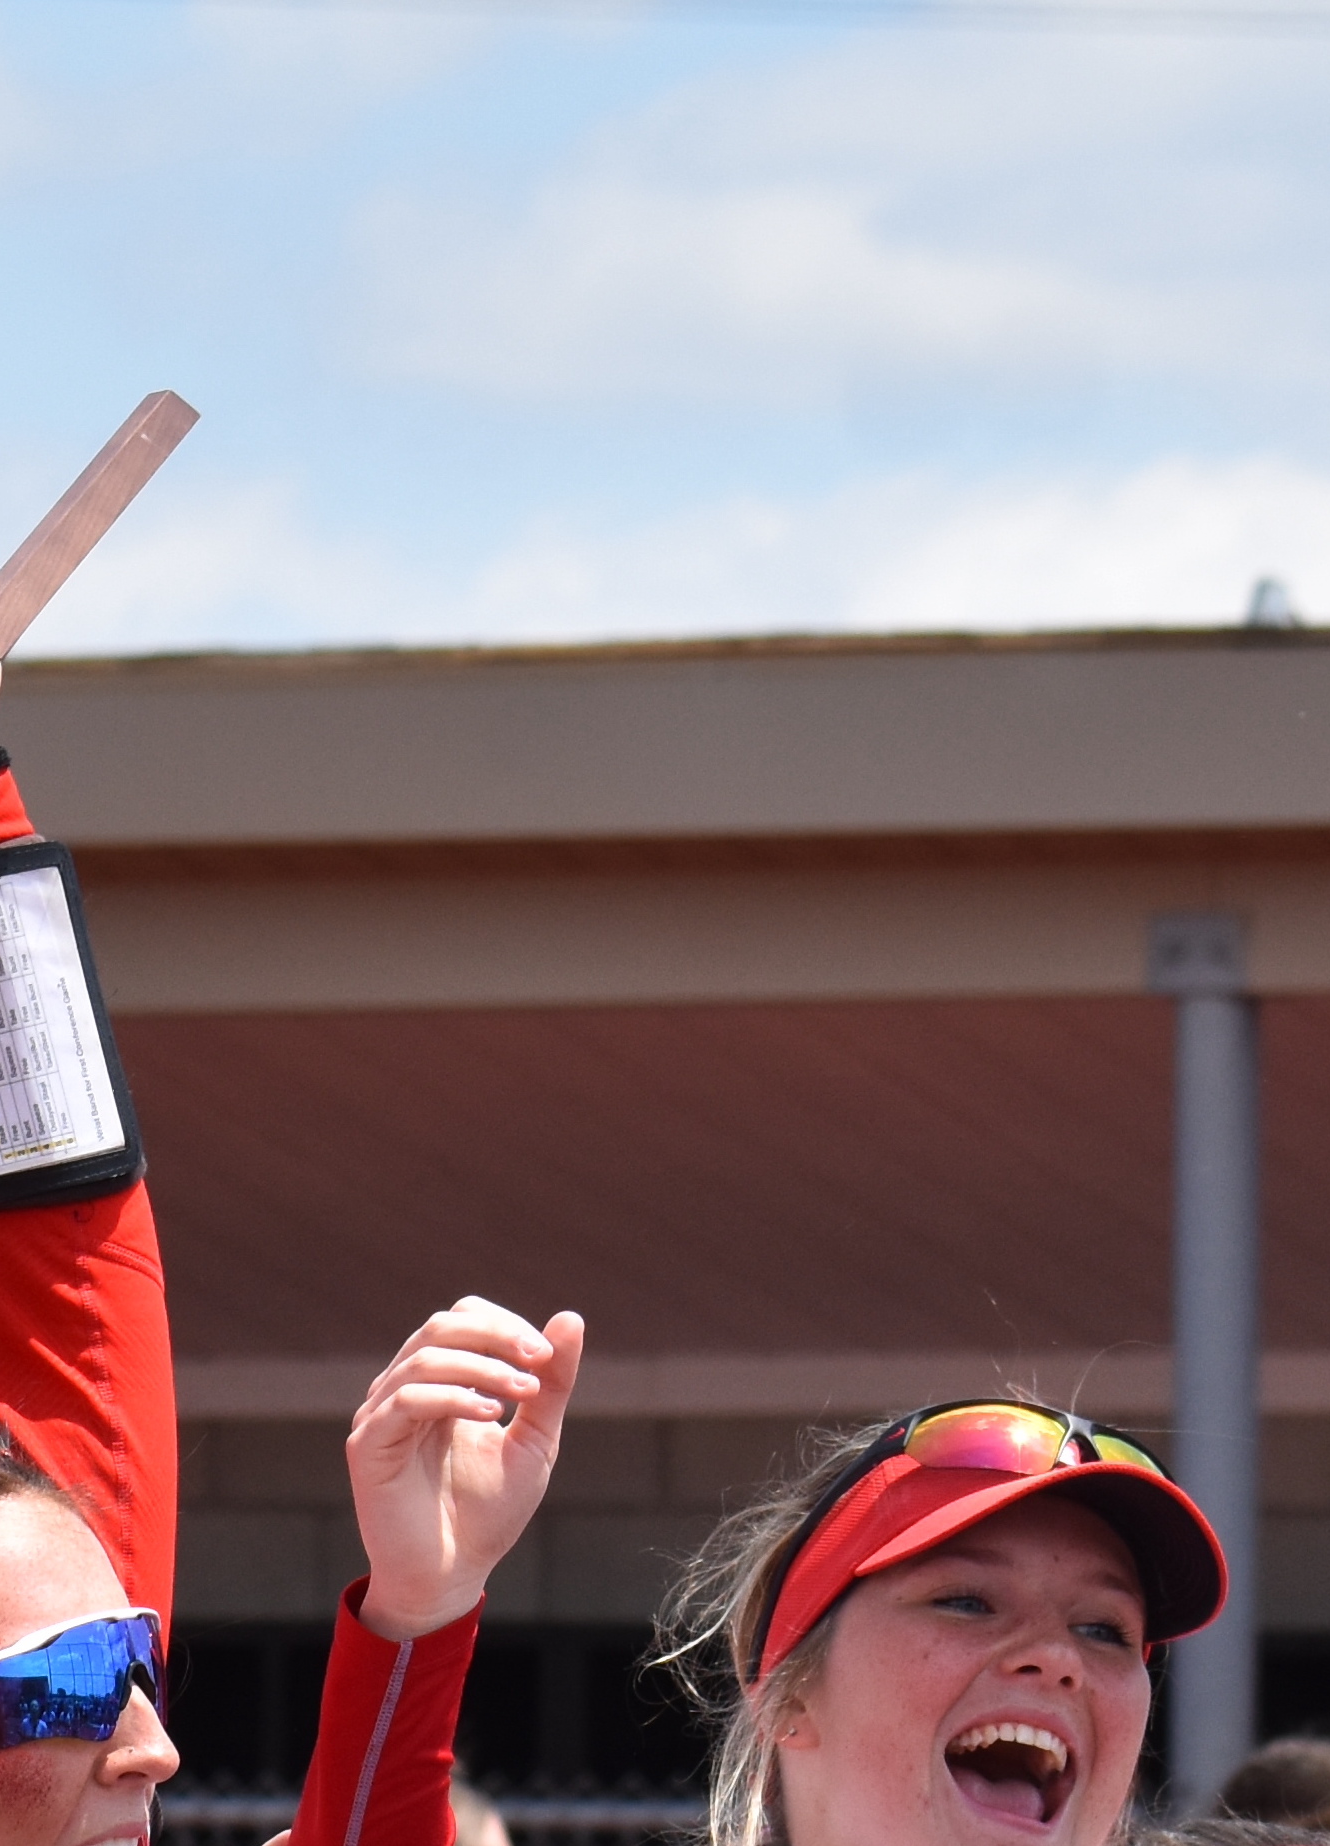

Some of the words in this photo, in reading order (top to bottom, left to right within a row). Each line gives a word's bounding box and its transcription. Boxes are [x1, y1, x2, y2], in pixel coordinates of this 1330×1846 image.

[64, 1005, 83, 1056] Conference
[20, 1057, 29, 1074] Free
[78, 1057, 88, 1077] First
[83, 1079, 92, 1091] for
[87, 1092, 98, 1116] Band
[10, 1124, 19, 1141] Free
